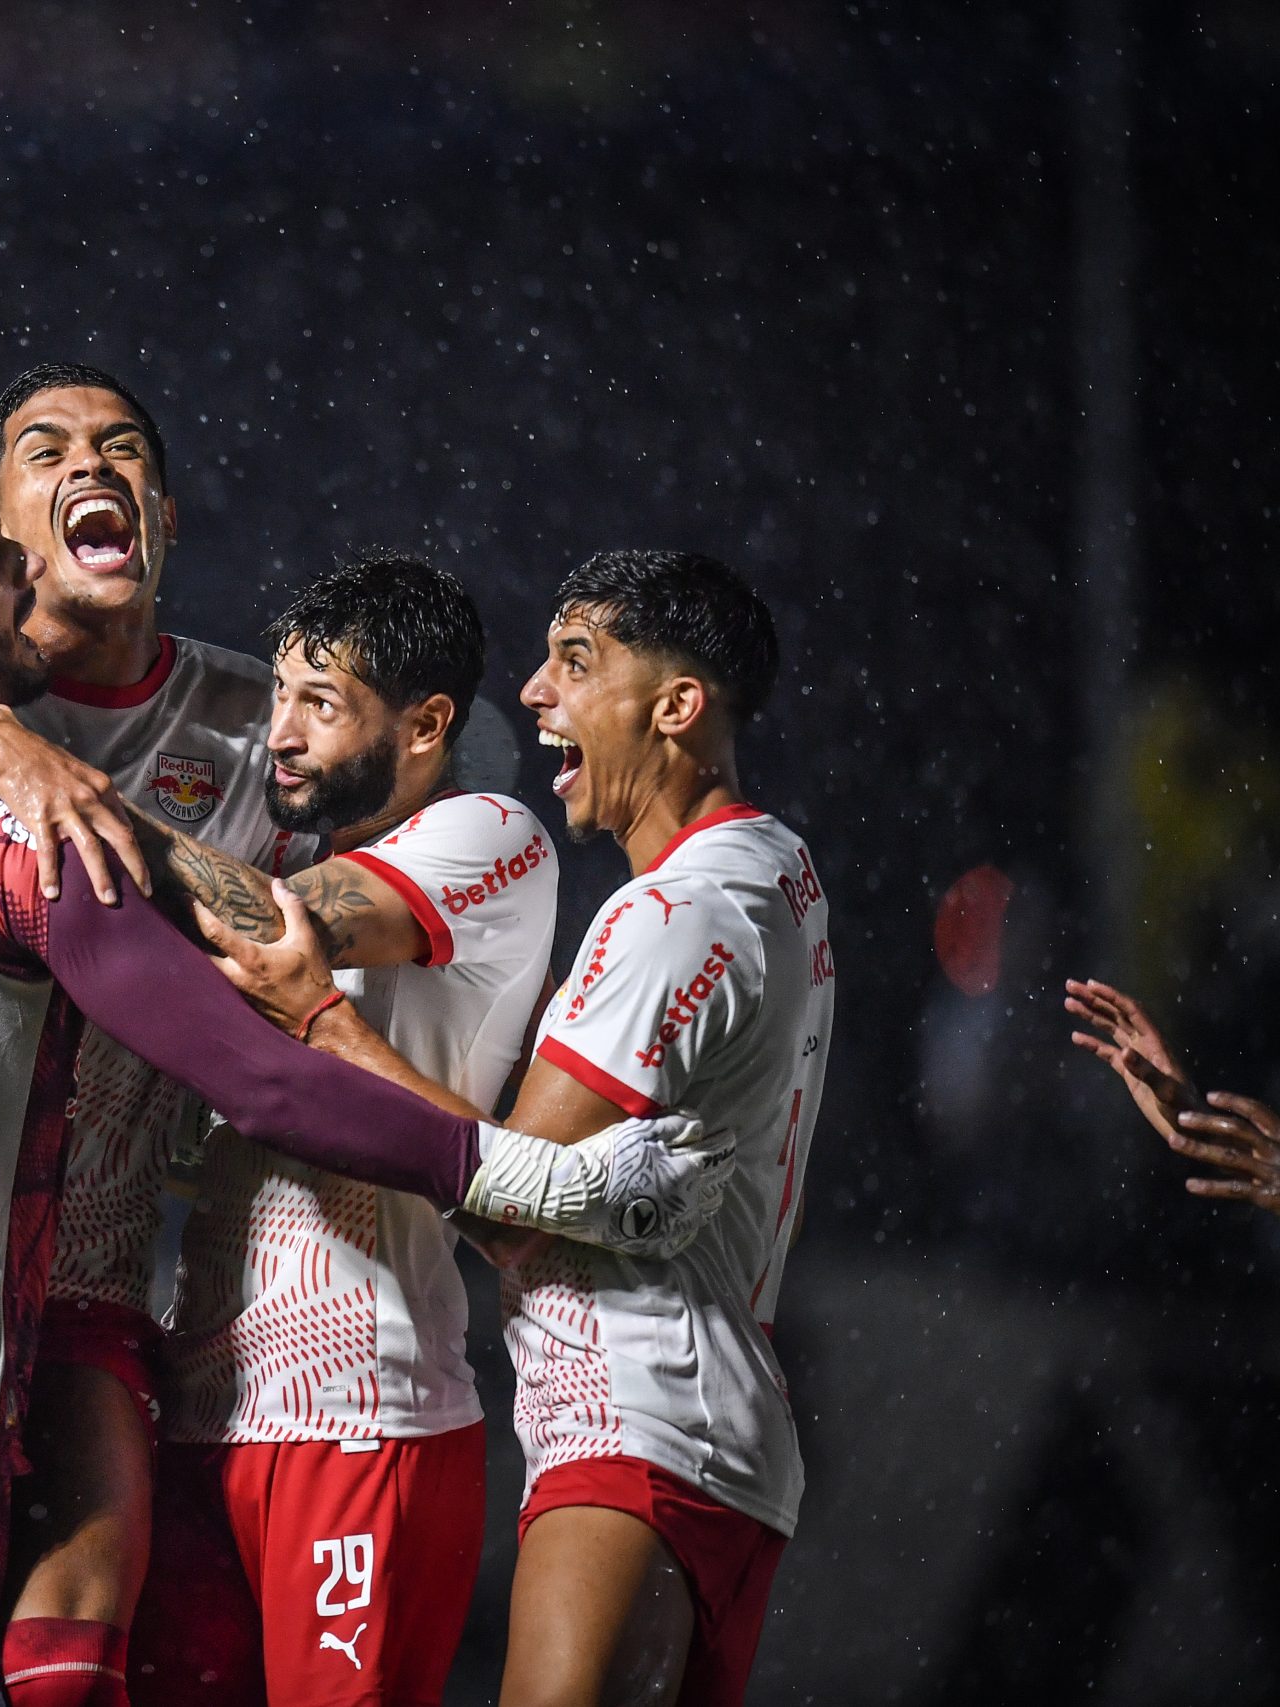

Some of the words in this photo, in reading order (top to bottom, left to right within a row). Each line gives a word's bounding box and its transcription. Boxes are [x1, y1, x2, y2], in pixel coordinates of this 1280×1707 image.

[441, 834, 548, 915] betfast
[777, 847, 822, 928] Red
[635, 943, 735, 1068] betfast
[313, 1533, 374, 1617] 29
